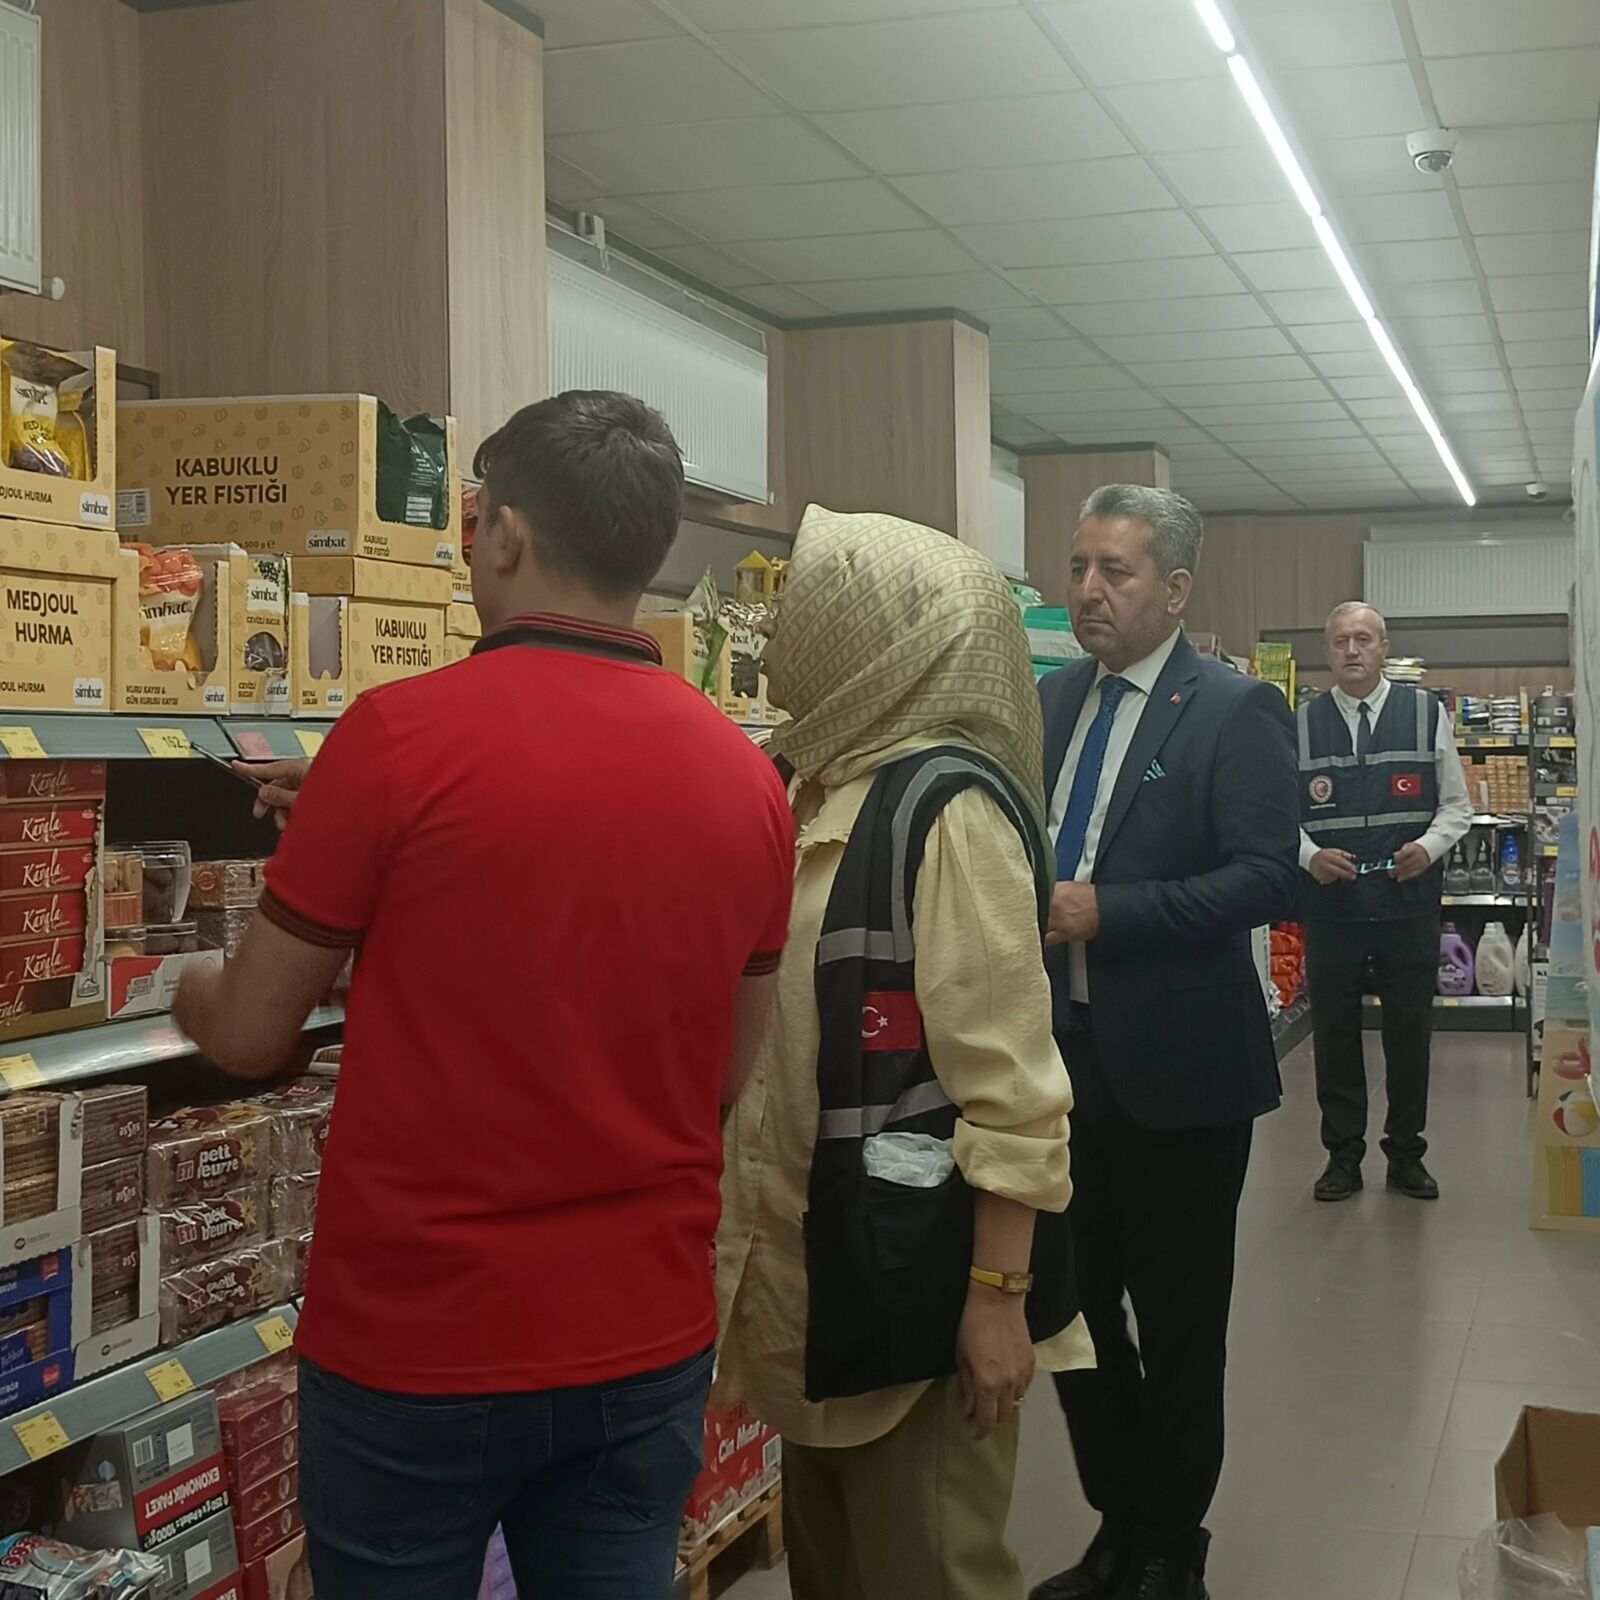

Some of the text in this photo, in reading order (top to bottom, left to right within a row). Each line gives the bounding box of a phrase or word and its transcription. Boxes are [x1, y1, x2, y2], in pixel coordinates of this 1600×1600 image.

[176, 456, 278, 477] KABUKLU
[24, 490, 53, 504] HURMA
[165, 478, 287, 505] YER FISTIĞI
[81, 500, 109, 516] simbat
[308, 535, 347, 549] simbat
[251, 587, 279, 601] simbat
[7, 589, 78, 617] MEDJOUL
[15, 622, 73, 645] HURMA
[375, 617, 426, 640] KABUKLU
[371, 643, 431, 667] YER FISTIĞI
[18, 682, 46, 693] HURMA
[75, 684, 102, 698] simbat
[267, 683, 288, 696] simbat
[205, 690, 224, 702] simbat
[145, 1466, 220, 1519] EKONOMİK PAKET
